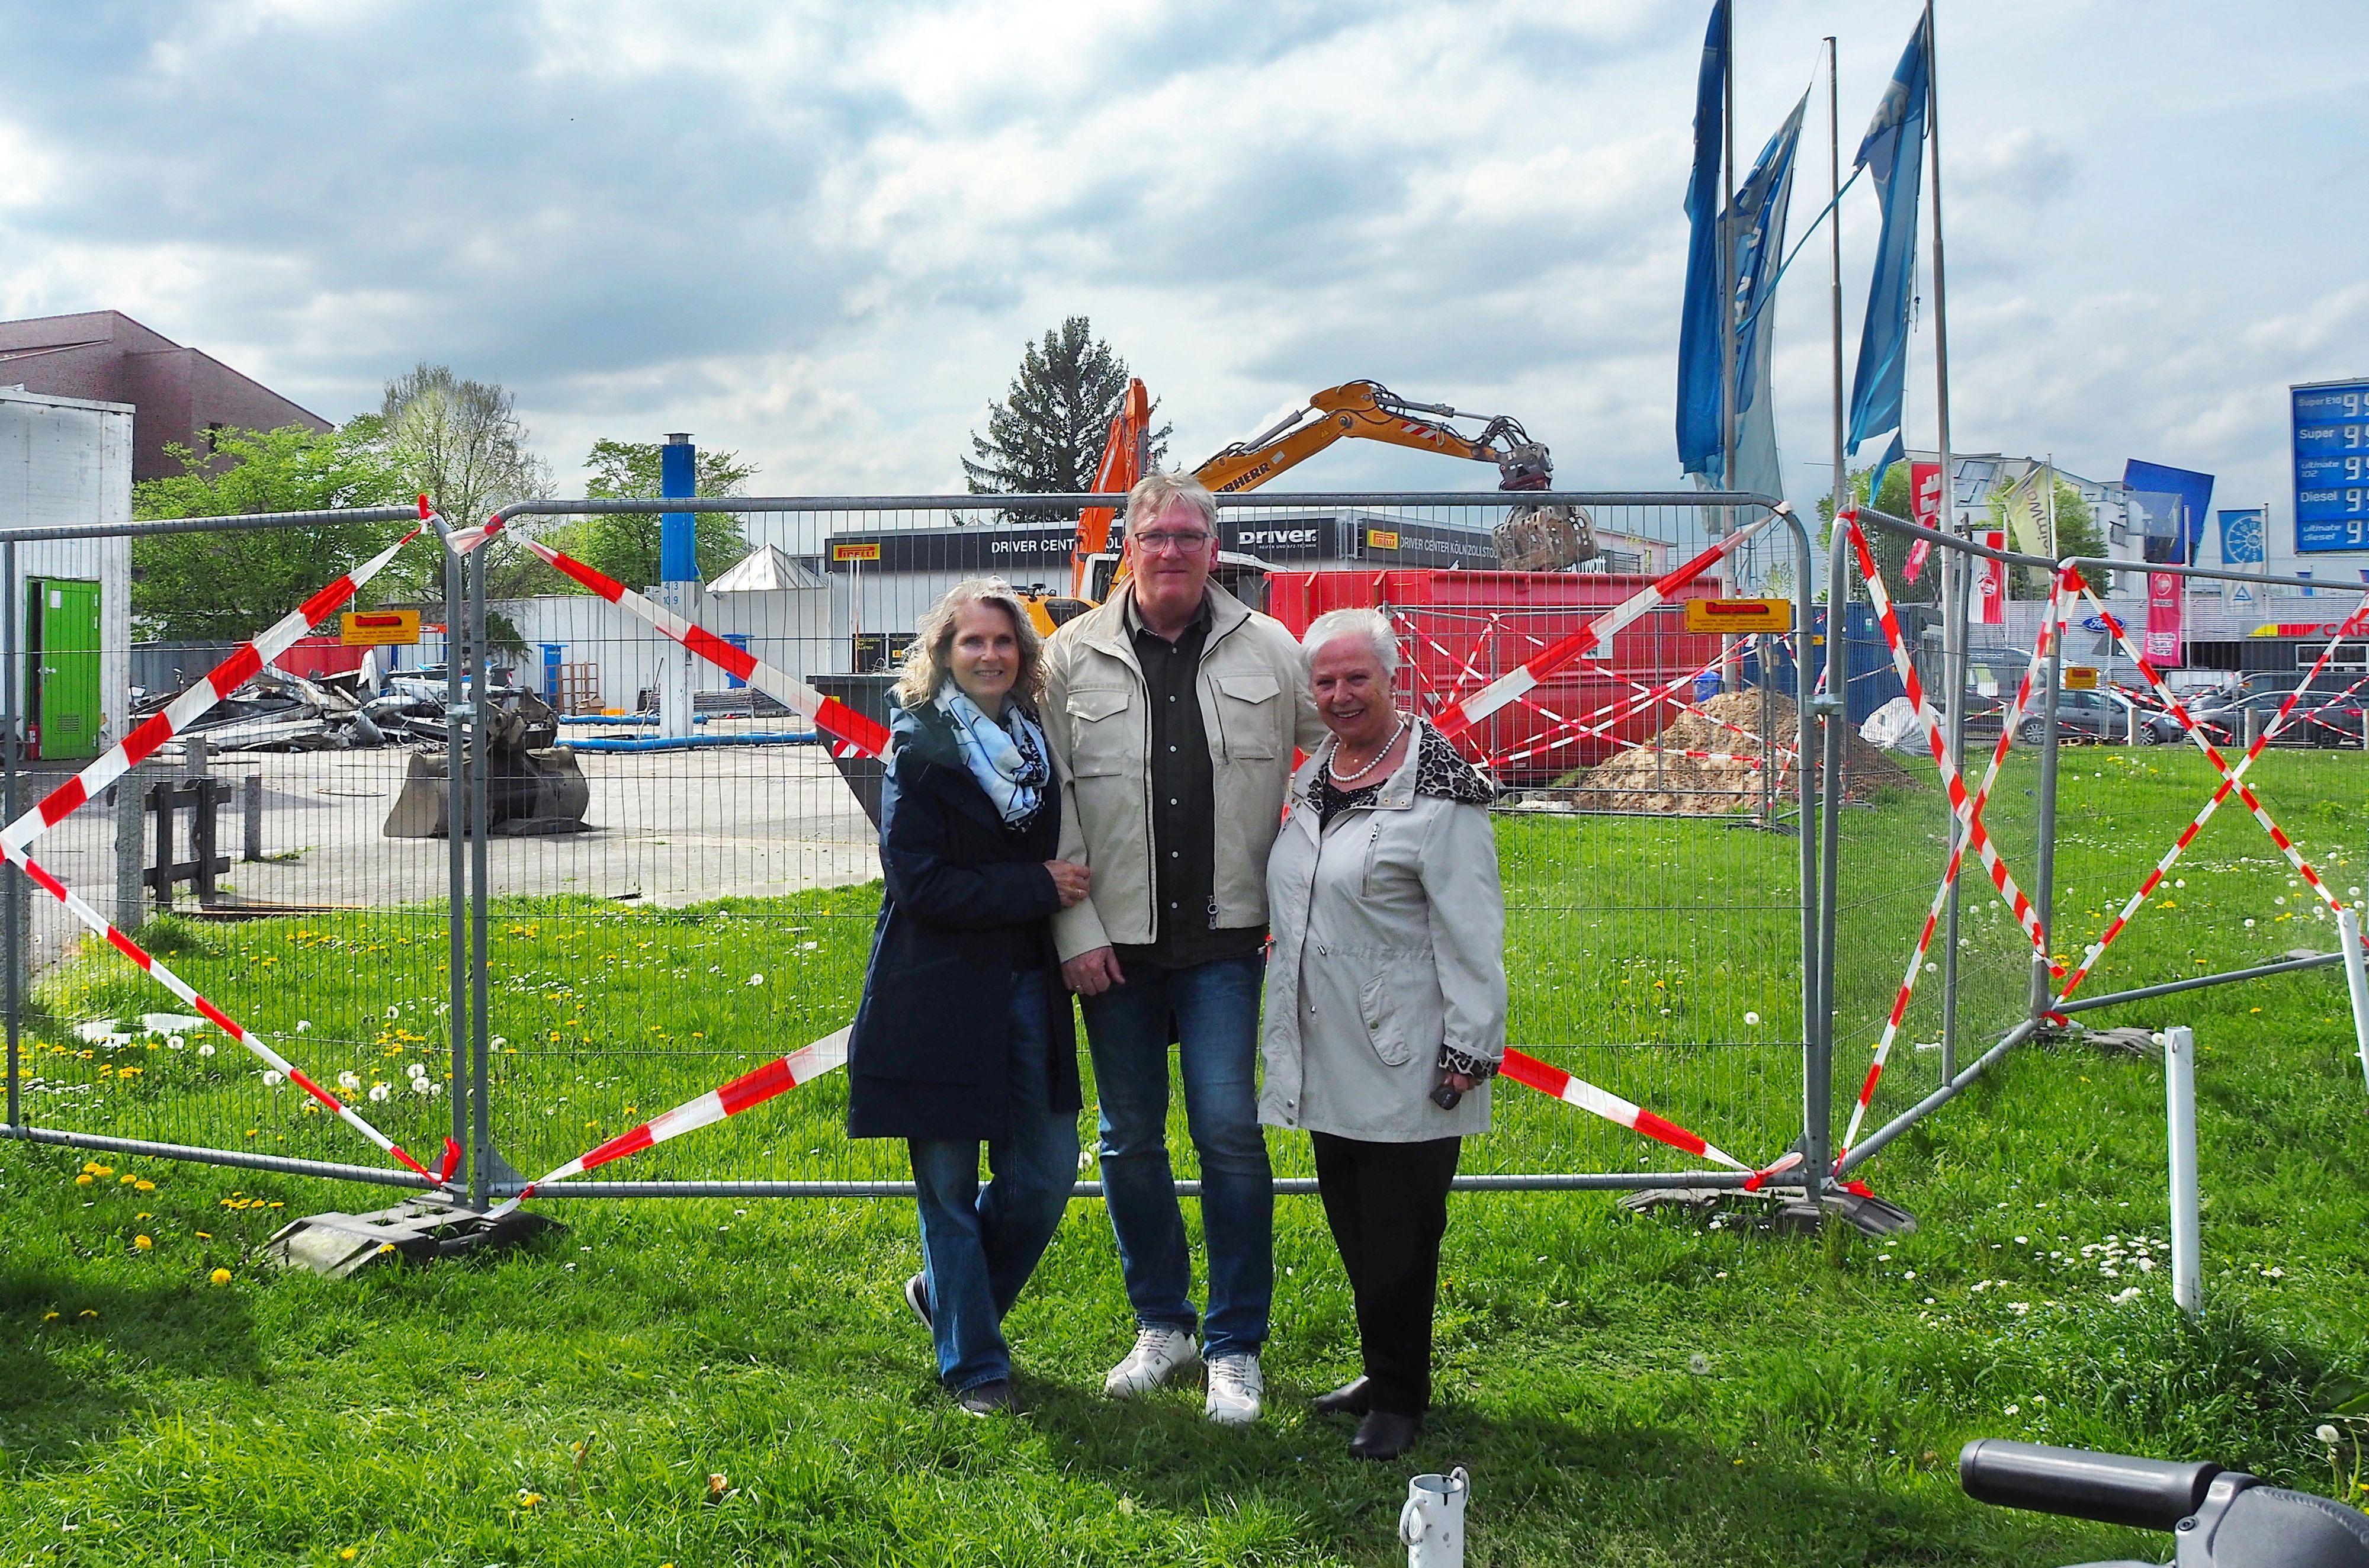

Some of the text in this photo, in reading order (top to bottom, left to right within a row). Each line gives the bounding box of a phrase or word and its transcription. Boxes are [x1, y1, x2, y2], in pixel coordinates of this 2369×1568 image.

[2299, 429, 2335, 441] Super
[2301, 460, 2339, 469] ultimate
[2300, 491, 2338, 502] Diesel
[2303, 523, 2342, 532] ultimate
[2303, 532, 2336, 541] diesel
[991, 540, 1036, 554] DRIVER
[1041, 538, 1075, 551] CENT
[1401, 536, 1498, 559] DRIVER CENTER KÖLN ZOLLSTOC
[838, 547, 875, 558] PIRELLI
